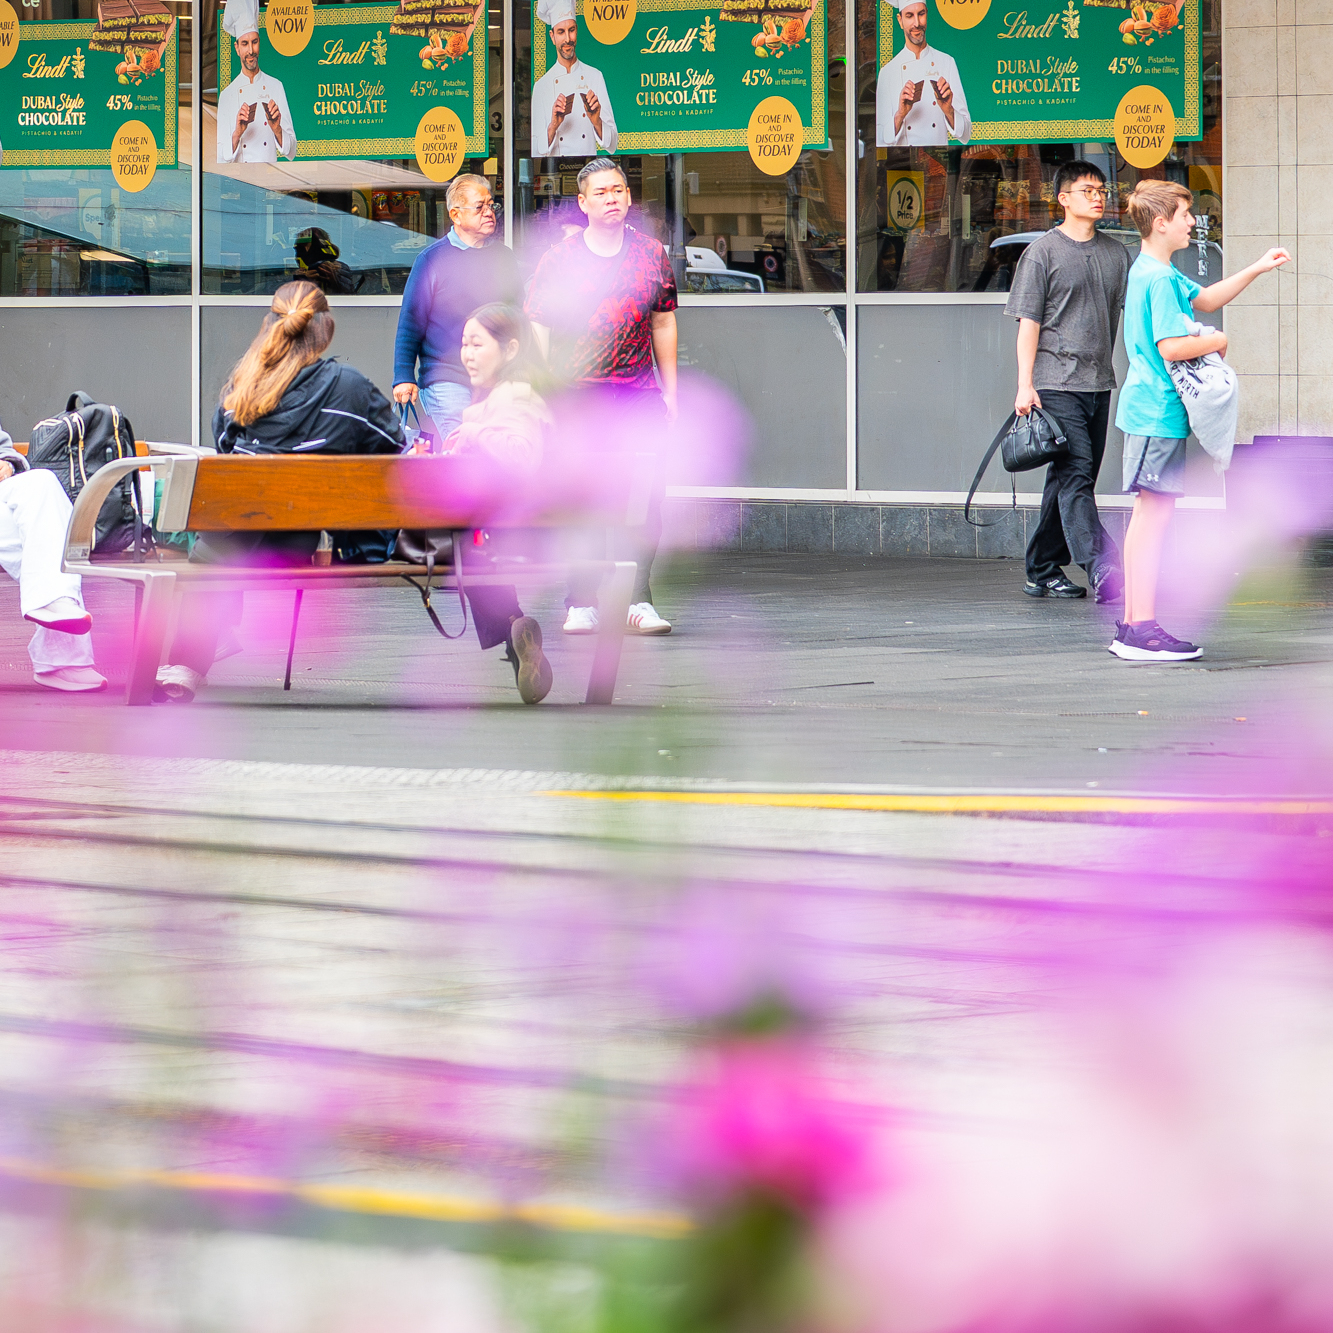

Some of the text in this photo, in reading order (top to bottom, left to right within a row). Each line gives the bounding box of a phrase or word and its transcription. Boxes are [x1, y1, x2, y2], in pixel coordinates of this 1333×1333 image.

[271, 5, 309, 16] AVAILABLE
[591, 5, 629, 21] NOW
[273, 17, 307, 34] NOW
[997, 11, 1060, 39] Lindt
[640, 26, 698, 54] Lindt
[318, 39, 371, 65] Lindt
[22, 53, 71, 79] Lindt
[997, 55, 1078, 79] DUBAI Style
[1108, 55, 1142, 75] 45%
[1162, 66, 1179, 76] filling
[641, 68, 715, 91] DUBAI Style
[742, 68, 772, 86] 45%
[791, 77, 807, 87] filling
[992, 77, 1080, 94] CHOCOLATE
[318, 80, 385, 101] DUBAI Style
[410, 80, 438, 97] 45%
[22, 93, 85, 114] DUBAI Style
[106, 94, 133, 111] 45%
[636, 89, 717, 106] CHOCOLATE
[313, 99, 387, 116] CHOCOLATE
[1125, 104, 1163, 114] COME IN
[18, 111, 86, 126] CHOCOLATE
[757, 114, 792, 124] COME IN
[424, 124, 456, 133] COME IN
[1122, 125, 1165, 135] DISCOVER
[119, 137, 148, 145] COME IN
[422, 143, 458, 151] DISCOVER
[755, 134, 794, 144] DISCOVER
[1125, 135, 1165, 148] TODAY
[117, 154, 150, 163] DISCOVER
[424, 153, 457, 165] TODAY
[757, 144, 794, 157] TODAY
[119, 164, 149, 176] TODAY
[897, 190, 913, 210] 1/2
[897, 211, 913, 219] Price
[588, 297, 641, 324] AXA
[1177, 376, 1200, 399] WORTH
